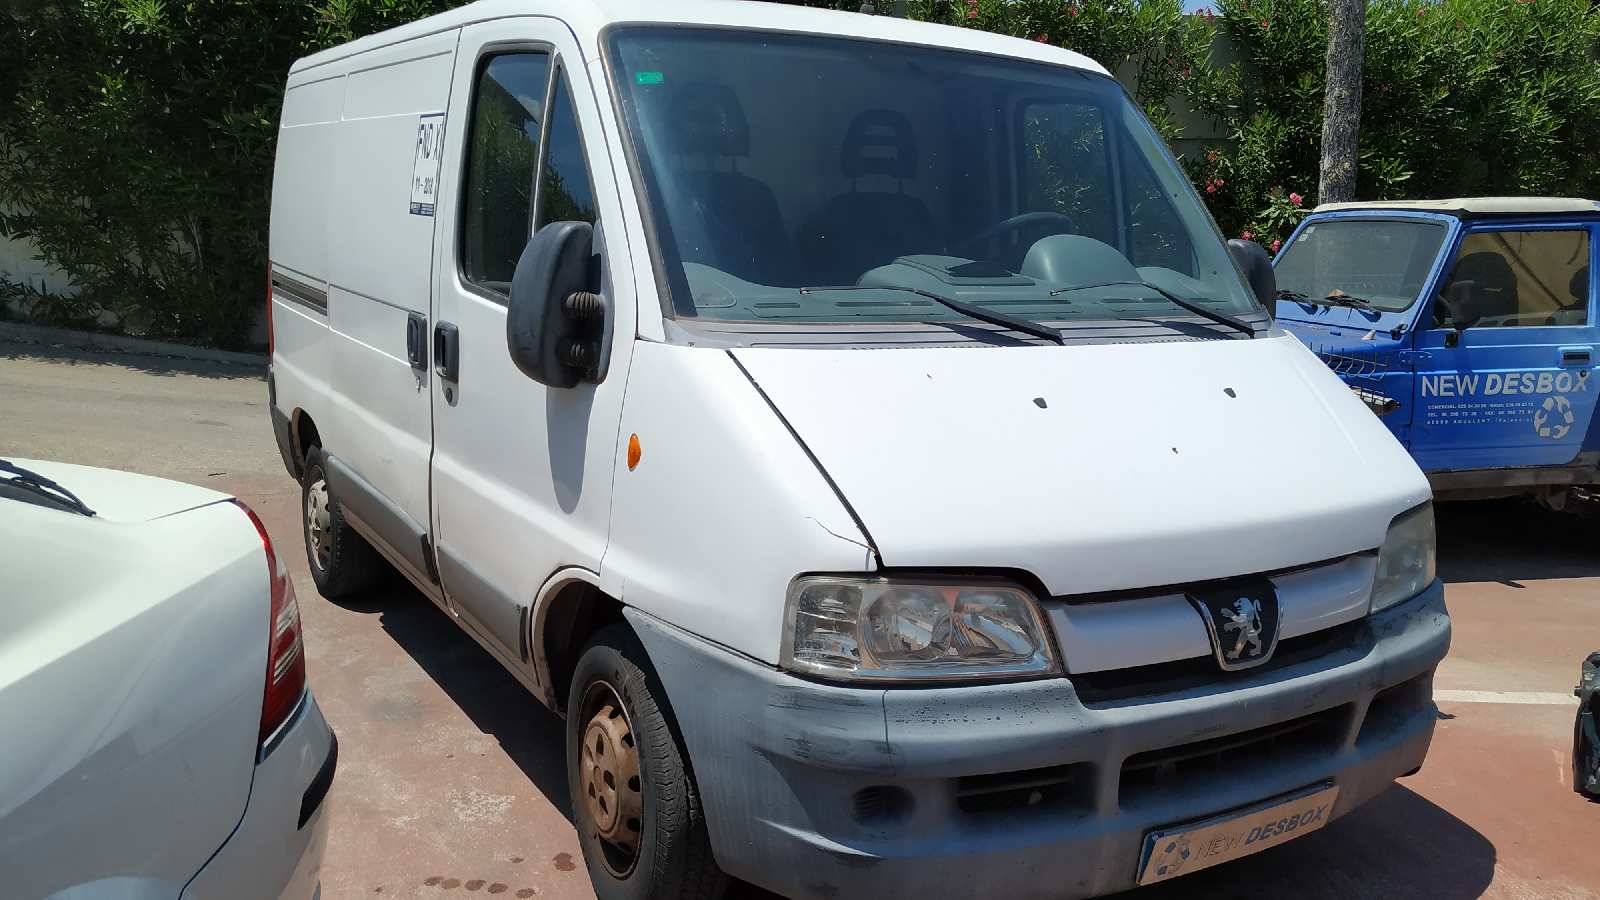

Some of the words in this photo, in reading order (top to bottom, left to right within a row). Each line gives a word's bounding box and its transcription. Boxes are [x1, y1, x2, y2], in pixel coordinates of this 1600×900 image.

[1421, 375, 1478, 397] NEW
[1484, 371, 1590, 395] DESBOX
[1197, 832, 1244, 858] NEW
[1245, 804, 1328, 844] DESBOX
